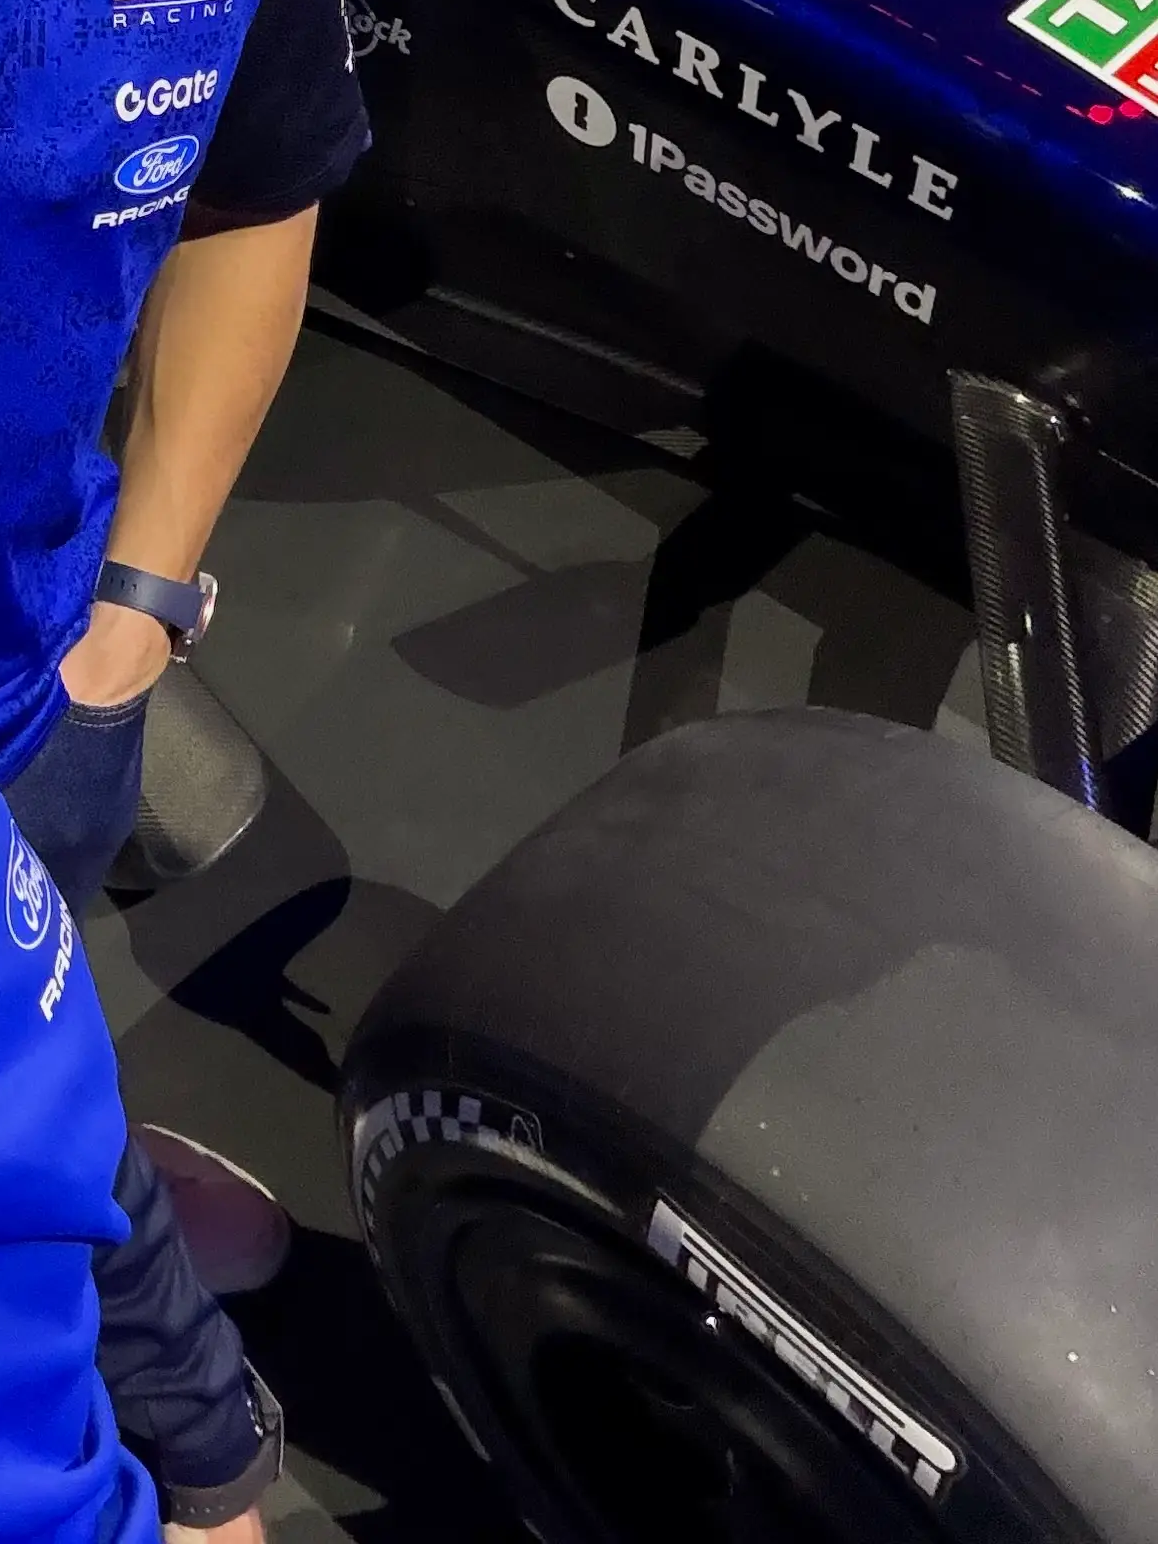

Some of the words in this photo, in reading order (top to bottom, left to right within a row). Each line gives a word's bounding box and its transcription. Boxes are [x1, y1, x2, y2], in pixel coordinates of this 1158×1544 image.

[113, 0, 234, 29] RACING
[345, 1, 412, 56] ock
[146, 68, 219, 117] Gate
[132, 142, 187, 186] Ford
[92, 185, 191, 230] RACING
[628, 122, 937, 325] 1Password
